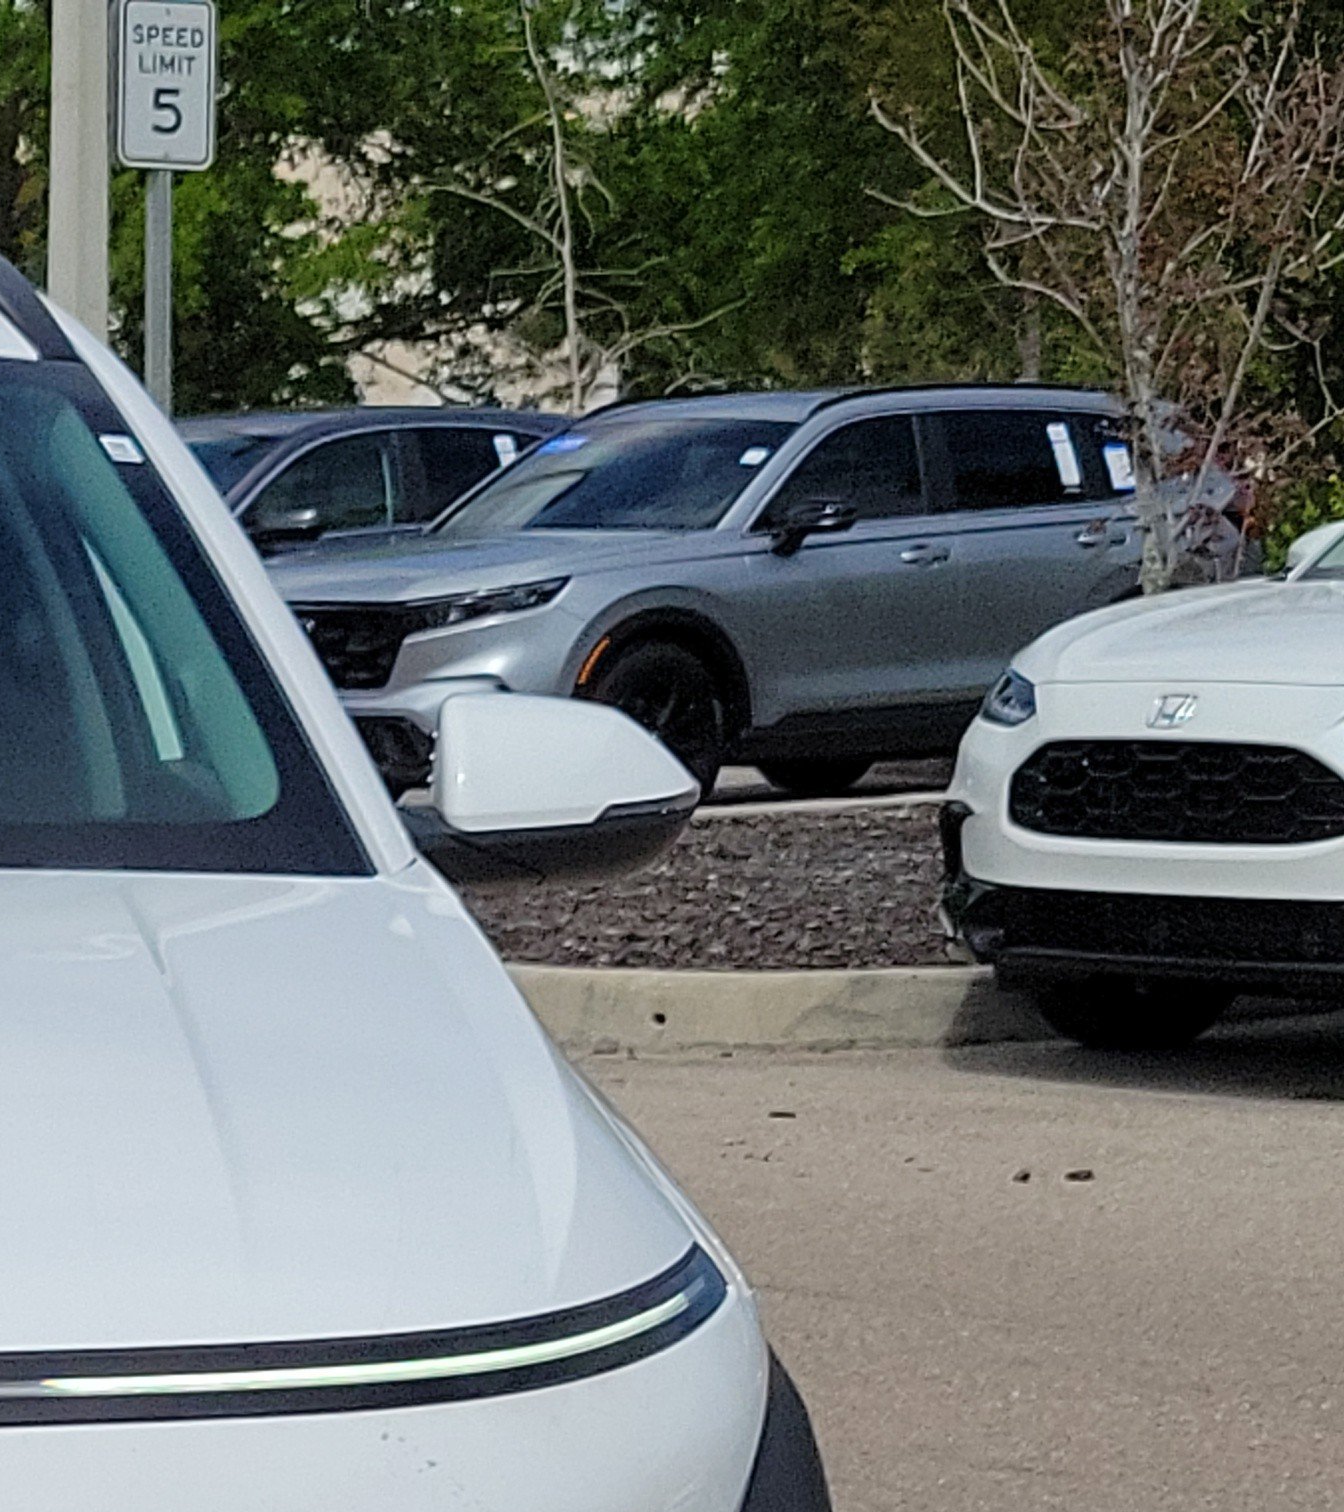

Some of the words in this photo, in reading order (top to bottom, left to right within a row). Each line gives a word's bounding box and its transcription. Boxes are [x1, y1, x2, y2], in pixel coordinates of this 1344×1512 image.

[133, 24, 204, 48] SPEED
[138, 54, 196, 75] LIMIT
[152, 88, 183, 134] 5
